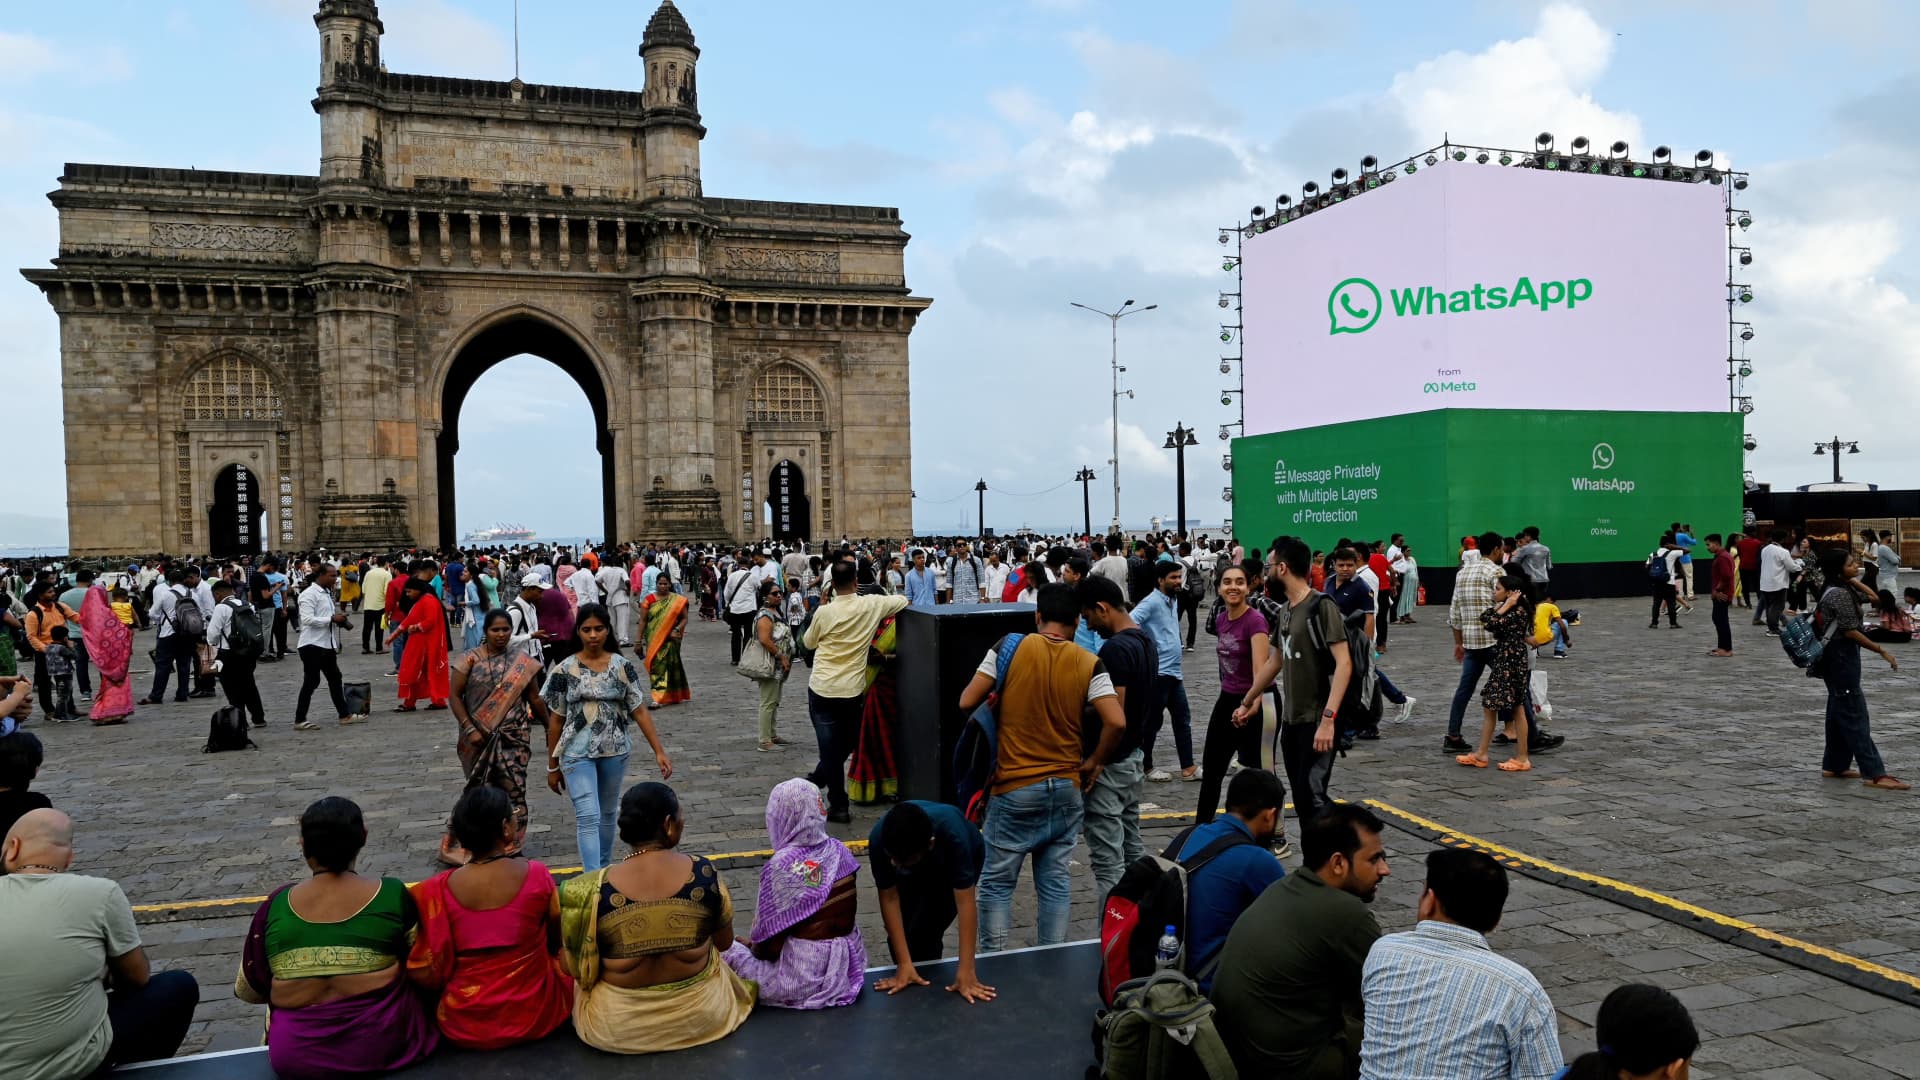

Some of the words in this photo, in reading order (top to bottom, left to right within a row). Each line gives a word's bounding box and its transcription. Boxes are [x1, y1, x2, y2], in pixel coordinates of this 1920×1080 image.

[1390, 277, 1592, 316] WhatsApp
[1438, 368, 1461, 376] from
[1441, 381, 1476, 392] Meta
[1287, 469, 1331, 484] Message
[1334, 462, 1381, 480] Privately
[1571, 477, 1635, 493] WhatsApp
[1277, 490, 1297, 504] with
[1299, 488, 1338, 504] Multiple
[1341, 487, 1378, 503] Layers
[1292, 509, 1303, 523] of
[1305, 507, 1357, 522] Protection
